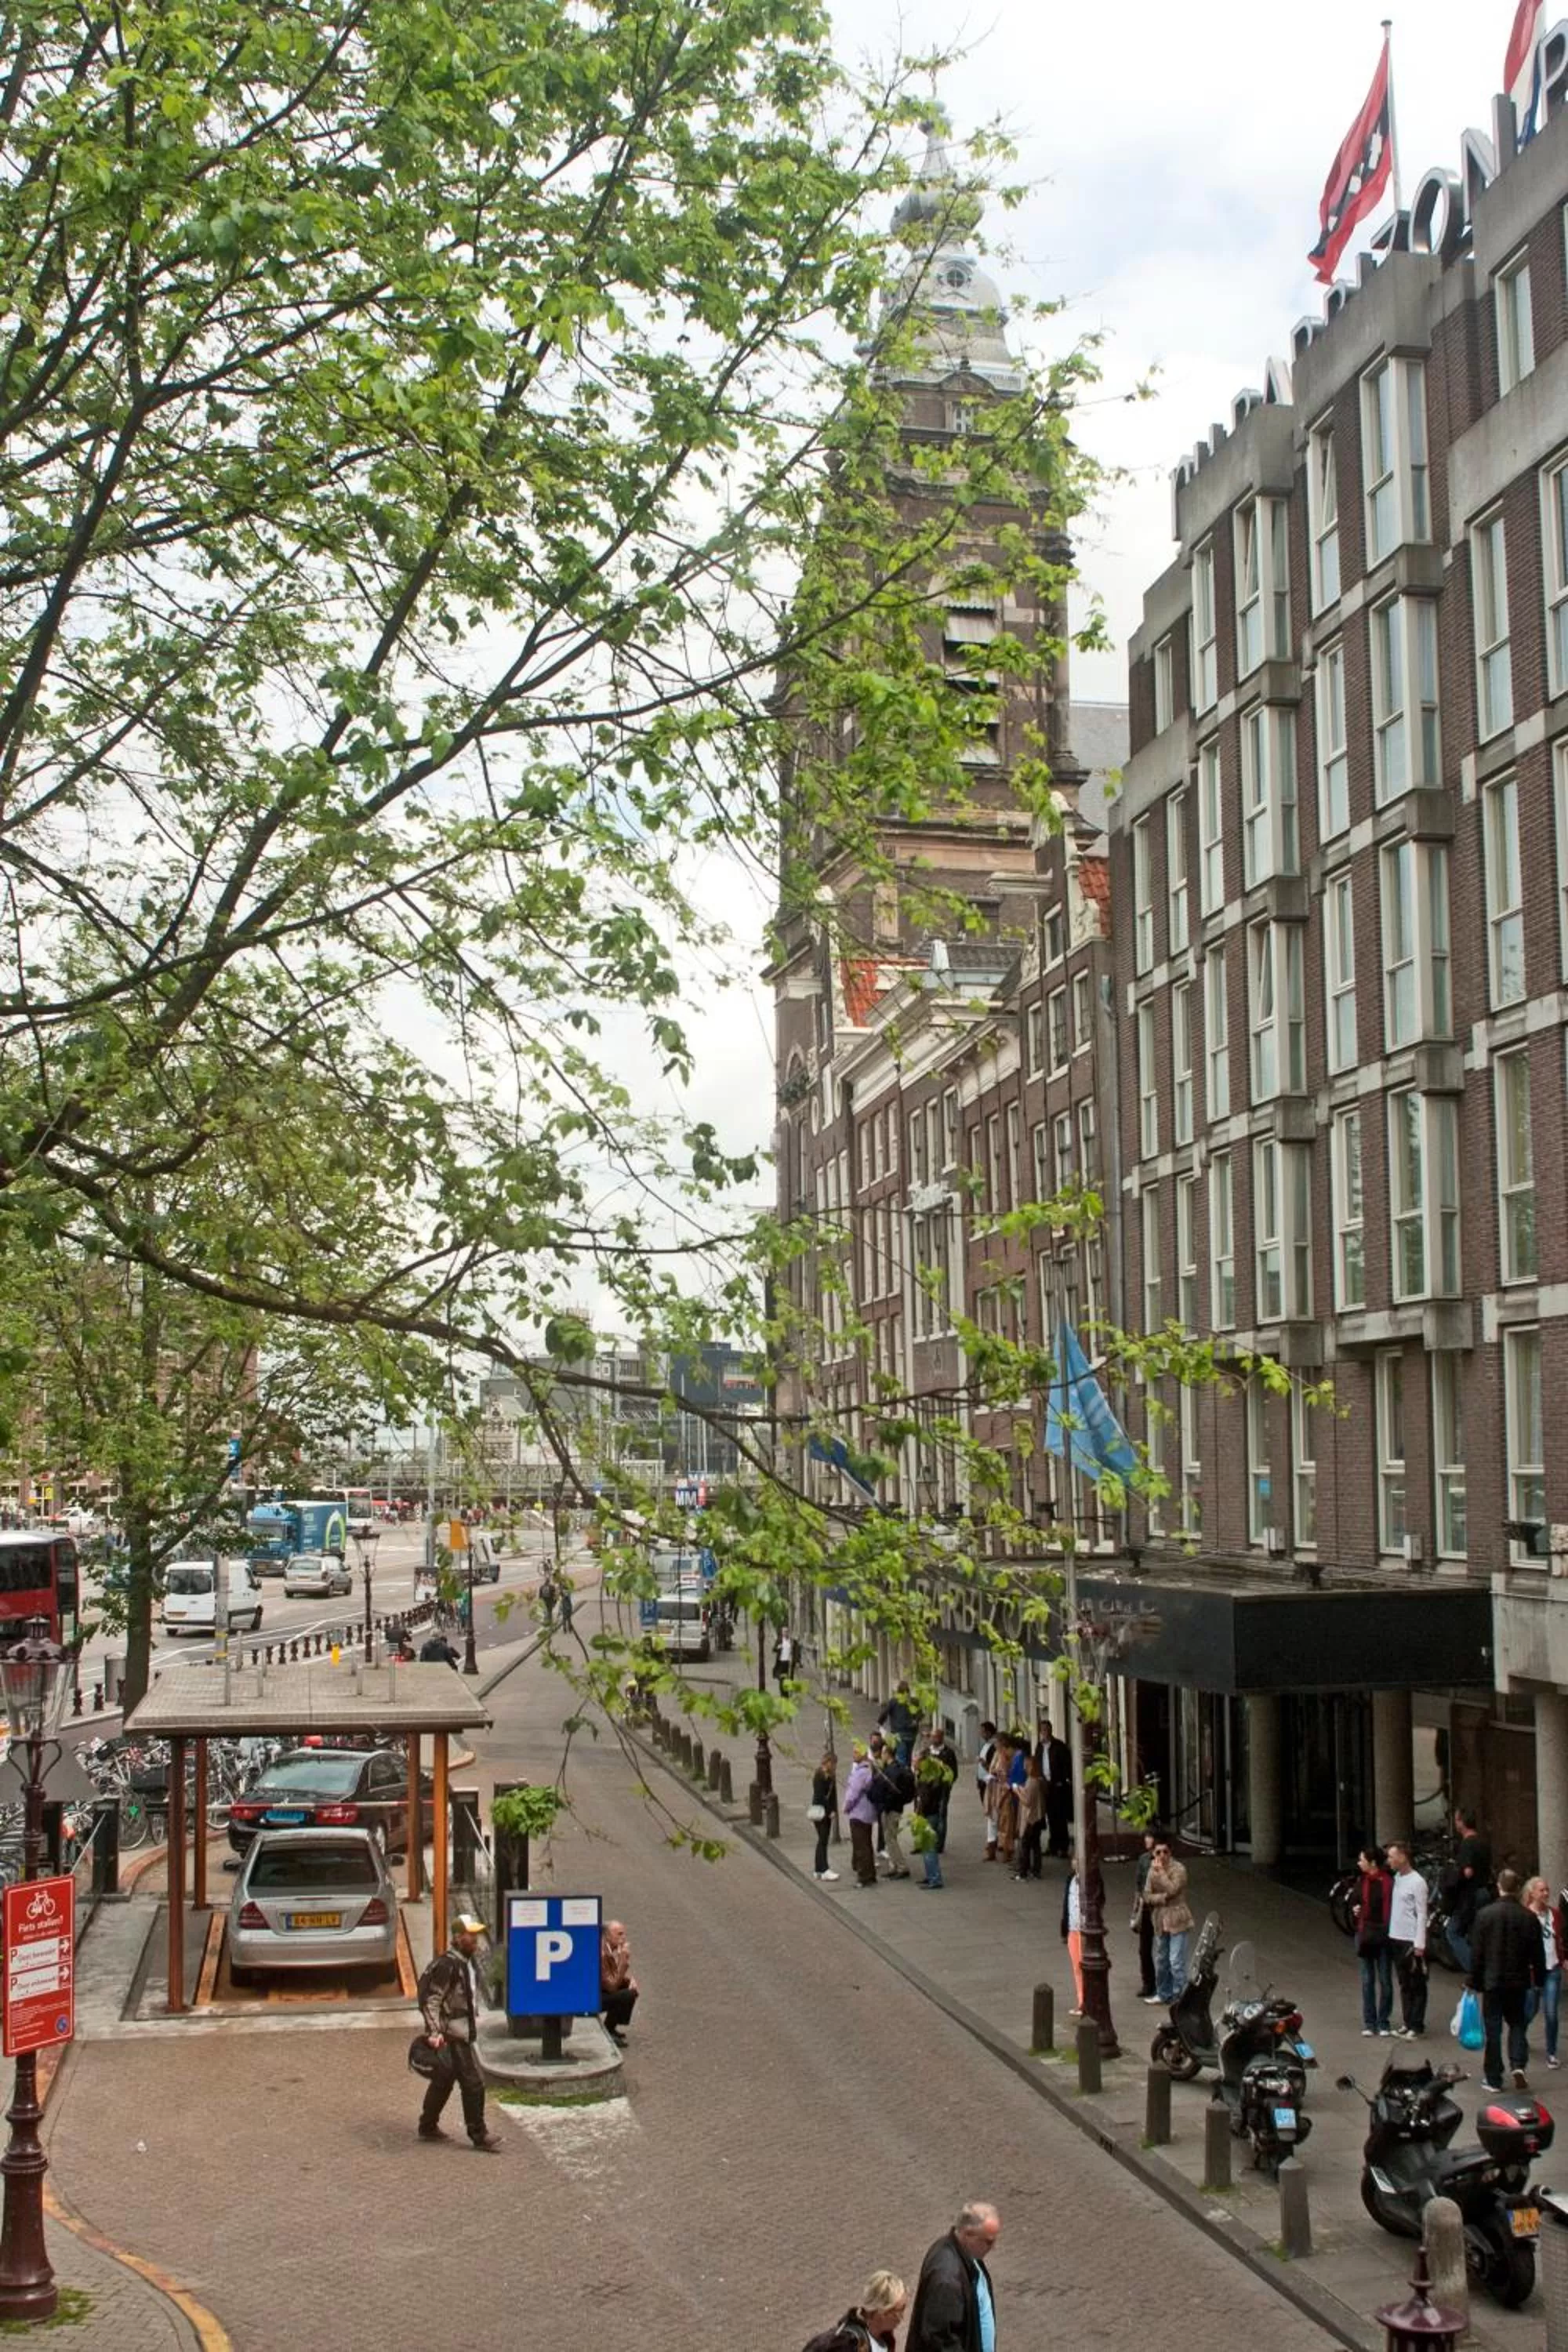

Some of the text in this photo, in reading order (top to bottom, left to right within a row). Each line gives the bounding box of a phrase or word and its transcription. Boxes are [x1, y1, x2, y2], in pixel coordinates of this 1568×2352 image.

[18, 1922, 35, 1934] Fiets
[10, 1948, 18, 1963] P
[533, 1931, 573, 1981] P
[10, 1977, 18, 1991] P
